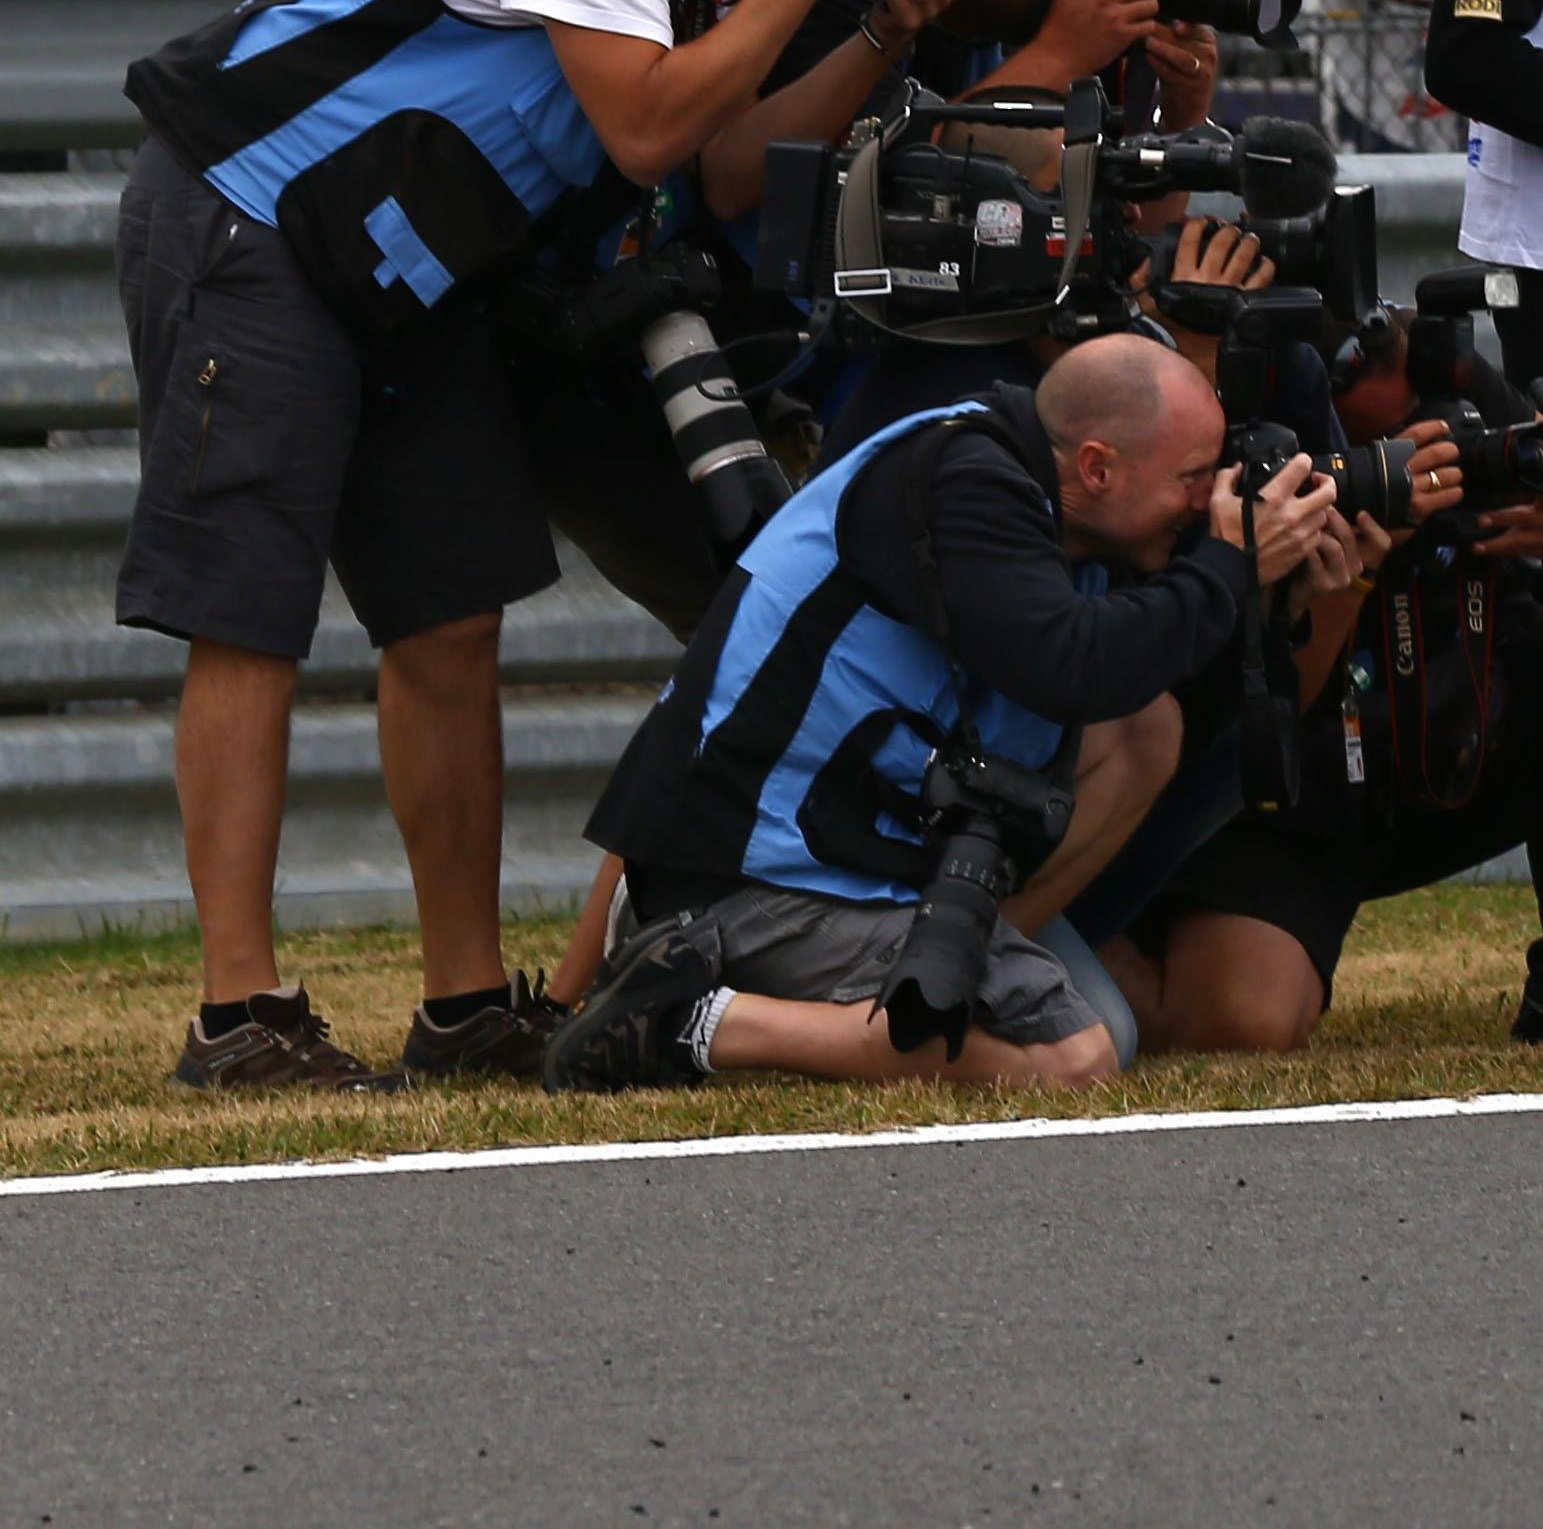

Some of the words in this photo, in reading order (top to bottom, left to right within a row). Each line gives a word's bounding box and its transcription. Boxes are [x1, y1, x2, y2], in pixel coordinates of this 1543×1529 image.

[938, 261, 961, 276] 83
[1467, 580, 1484, 634] EOS
[1394, 593, 1415, 676] Canon
